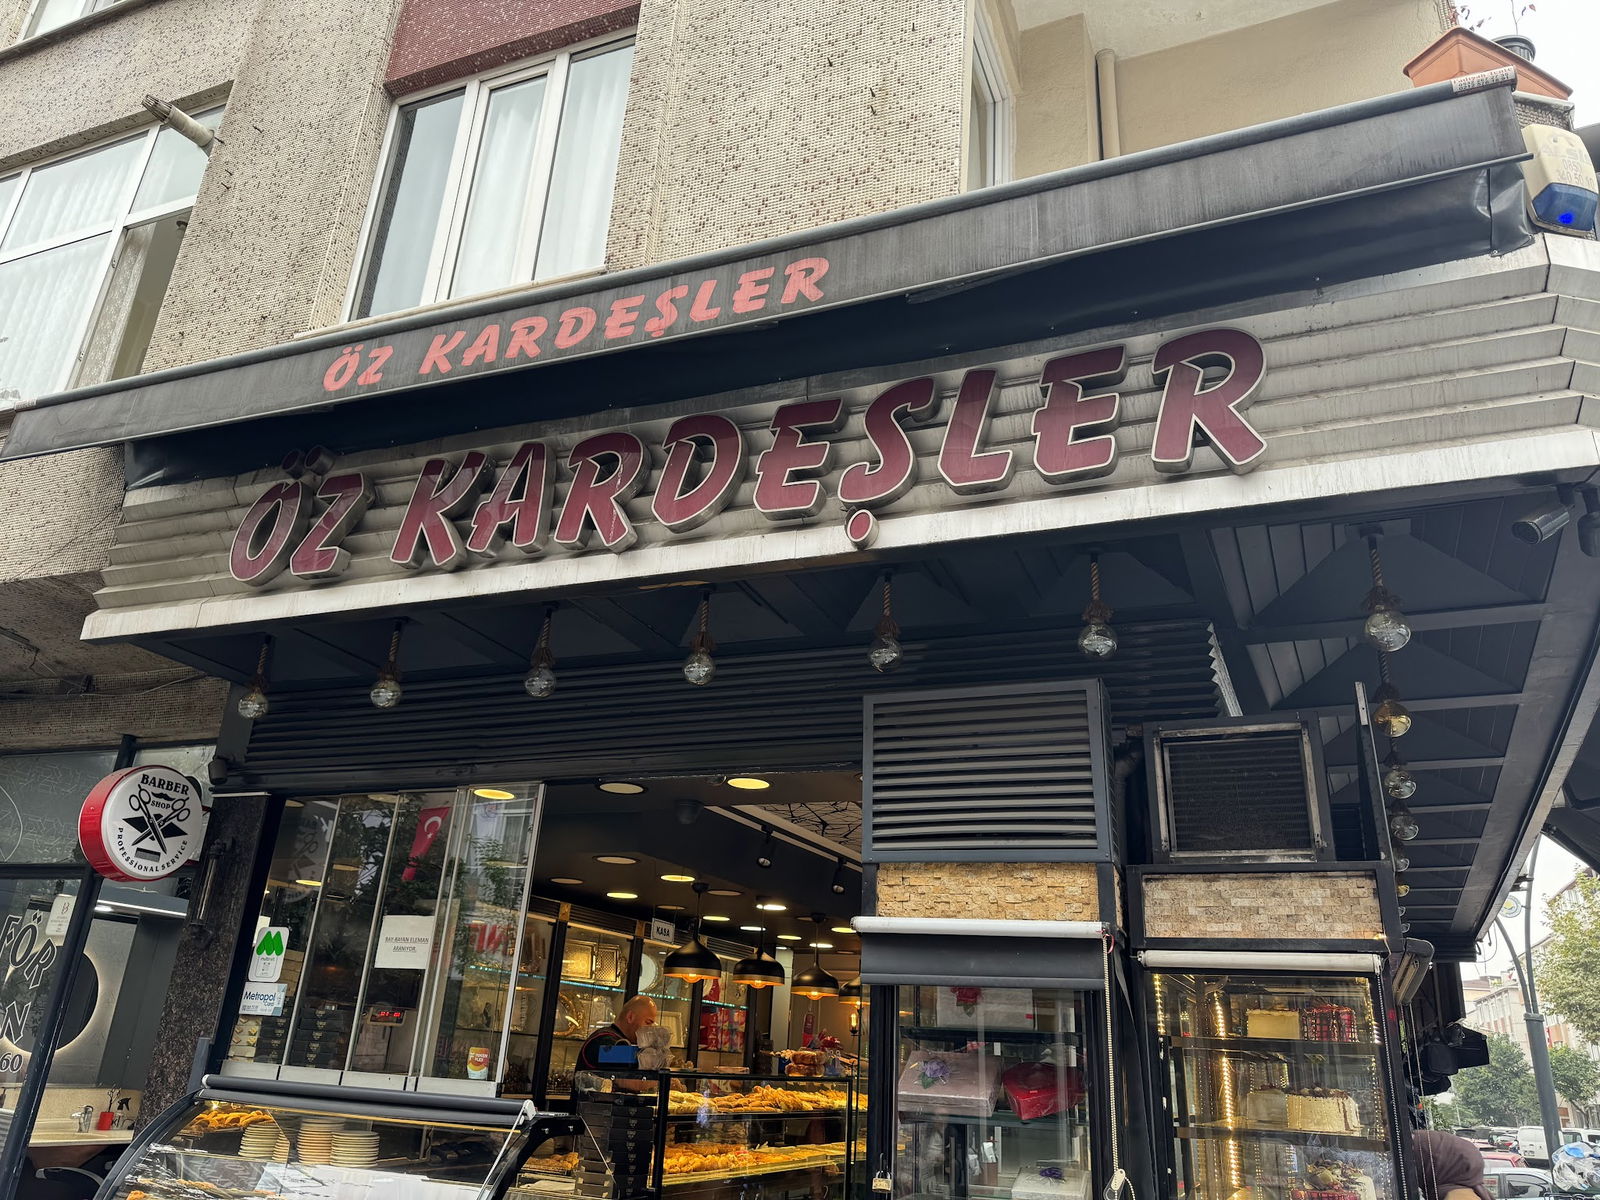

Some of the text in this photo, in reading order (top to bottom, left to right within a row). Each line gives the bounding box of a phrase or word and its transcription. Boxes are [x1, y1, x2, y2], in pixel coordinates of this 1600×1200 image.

[322, 257, 830, 391] ÖZ KARDEŞLER
[229, 327, 1268, 583] ÖZ KARDEŞLER
[140, 774, 189, 795] BARBER
[151, 800, 171, 810] SHOP
[656, 926, 670, 937] KASA
[243, 991, 277, 1004] Metropol
